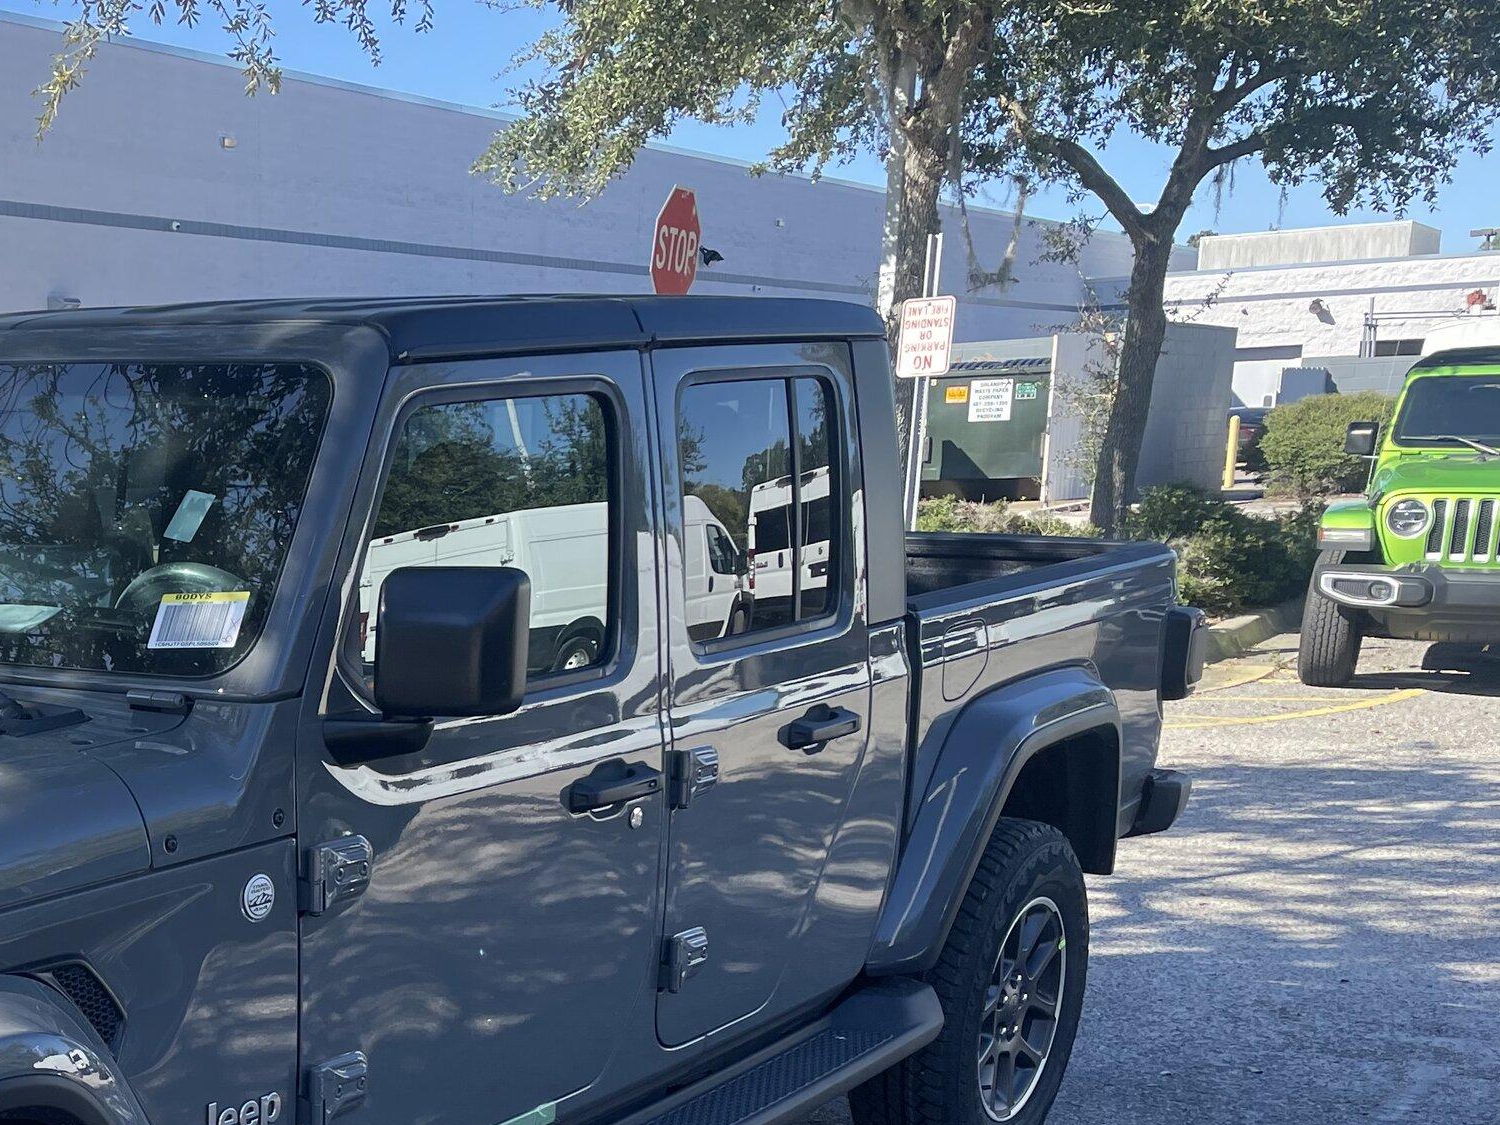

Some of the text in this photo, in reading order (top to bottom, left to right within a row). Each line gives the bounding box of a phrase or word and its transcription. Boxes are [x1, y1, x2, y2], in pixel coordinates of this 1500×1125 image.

[656, 225, 697, 276] STOP
[908, 304, 949, 317] FIRE LANE
[904, 318, 949, 330] STANDING
[920, 330, 932, 340] OR
[904, 341, 946, 352] PARKING
[913, 355, 932, 370] NO
